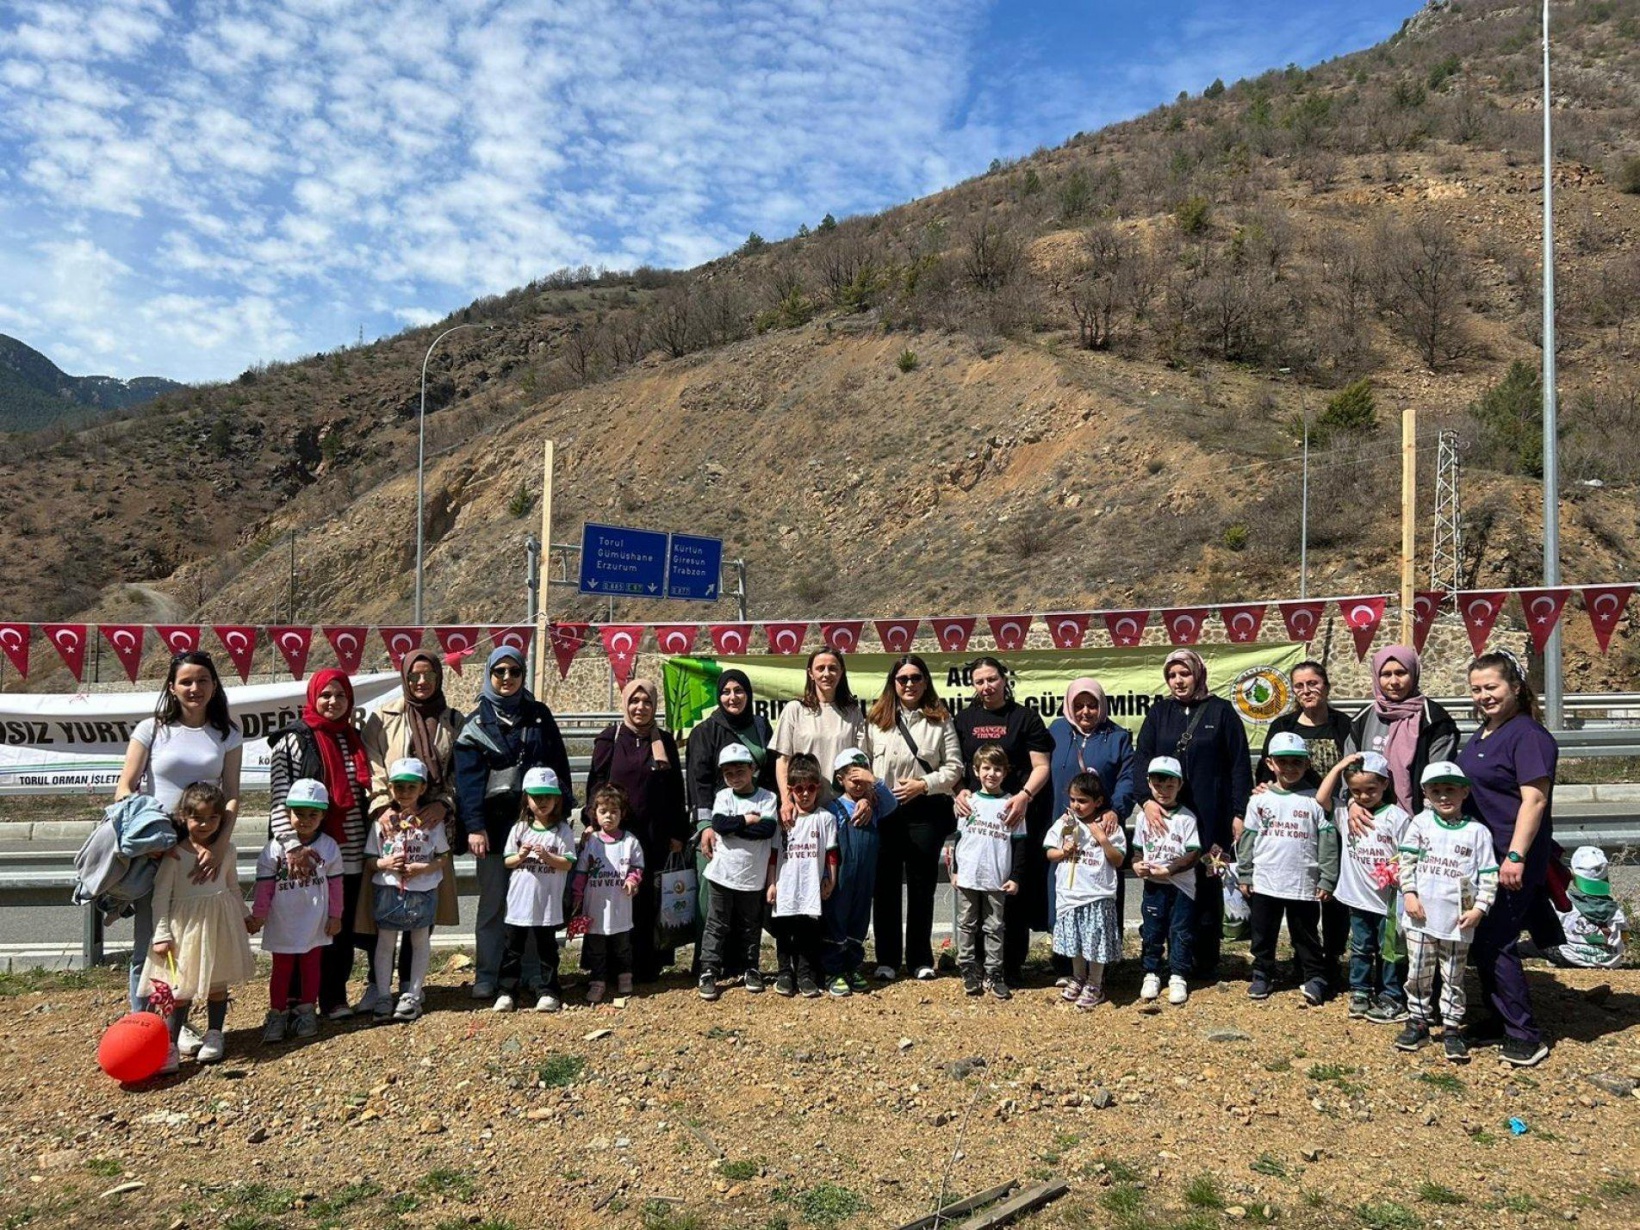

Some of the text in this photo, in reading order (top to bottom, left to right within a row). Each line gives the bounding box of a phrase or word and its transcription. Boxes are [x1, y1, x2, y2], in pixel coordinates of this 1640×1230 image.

[599, 537, 623, 547] Torul
[674, 555, 705, 565] Giresun
[597, 560, 637, 571] Erzurum
[673, 566, 705, 576] Trabzon
[19, 773, 121, 786] TORUL ORMAN İŞLET
[1293, 809, 1310, 819] OGM
[1274, 828, 1285, 837] VE
[1287, 830, 1309, 839] KORU
[1430, 865, 1441, 876] VE
